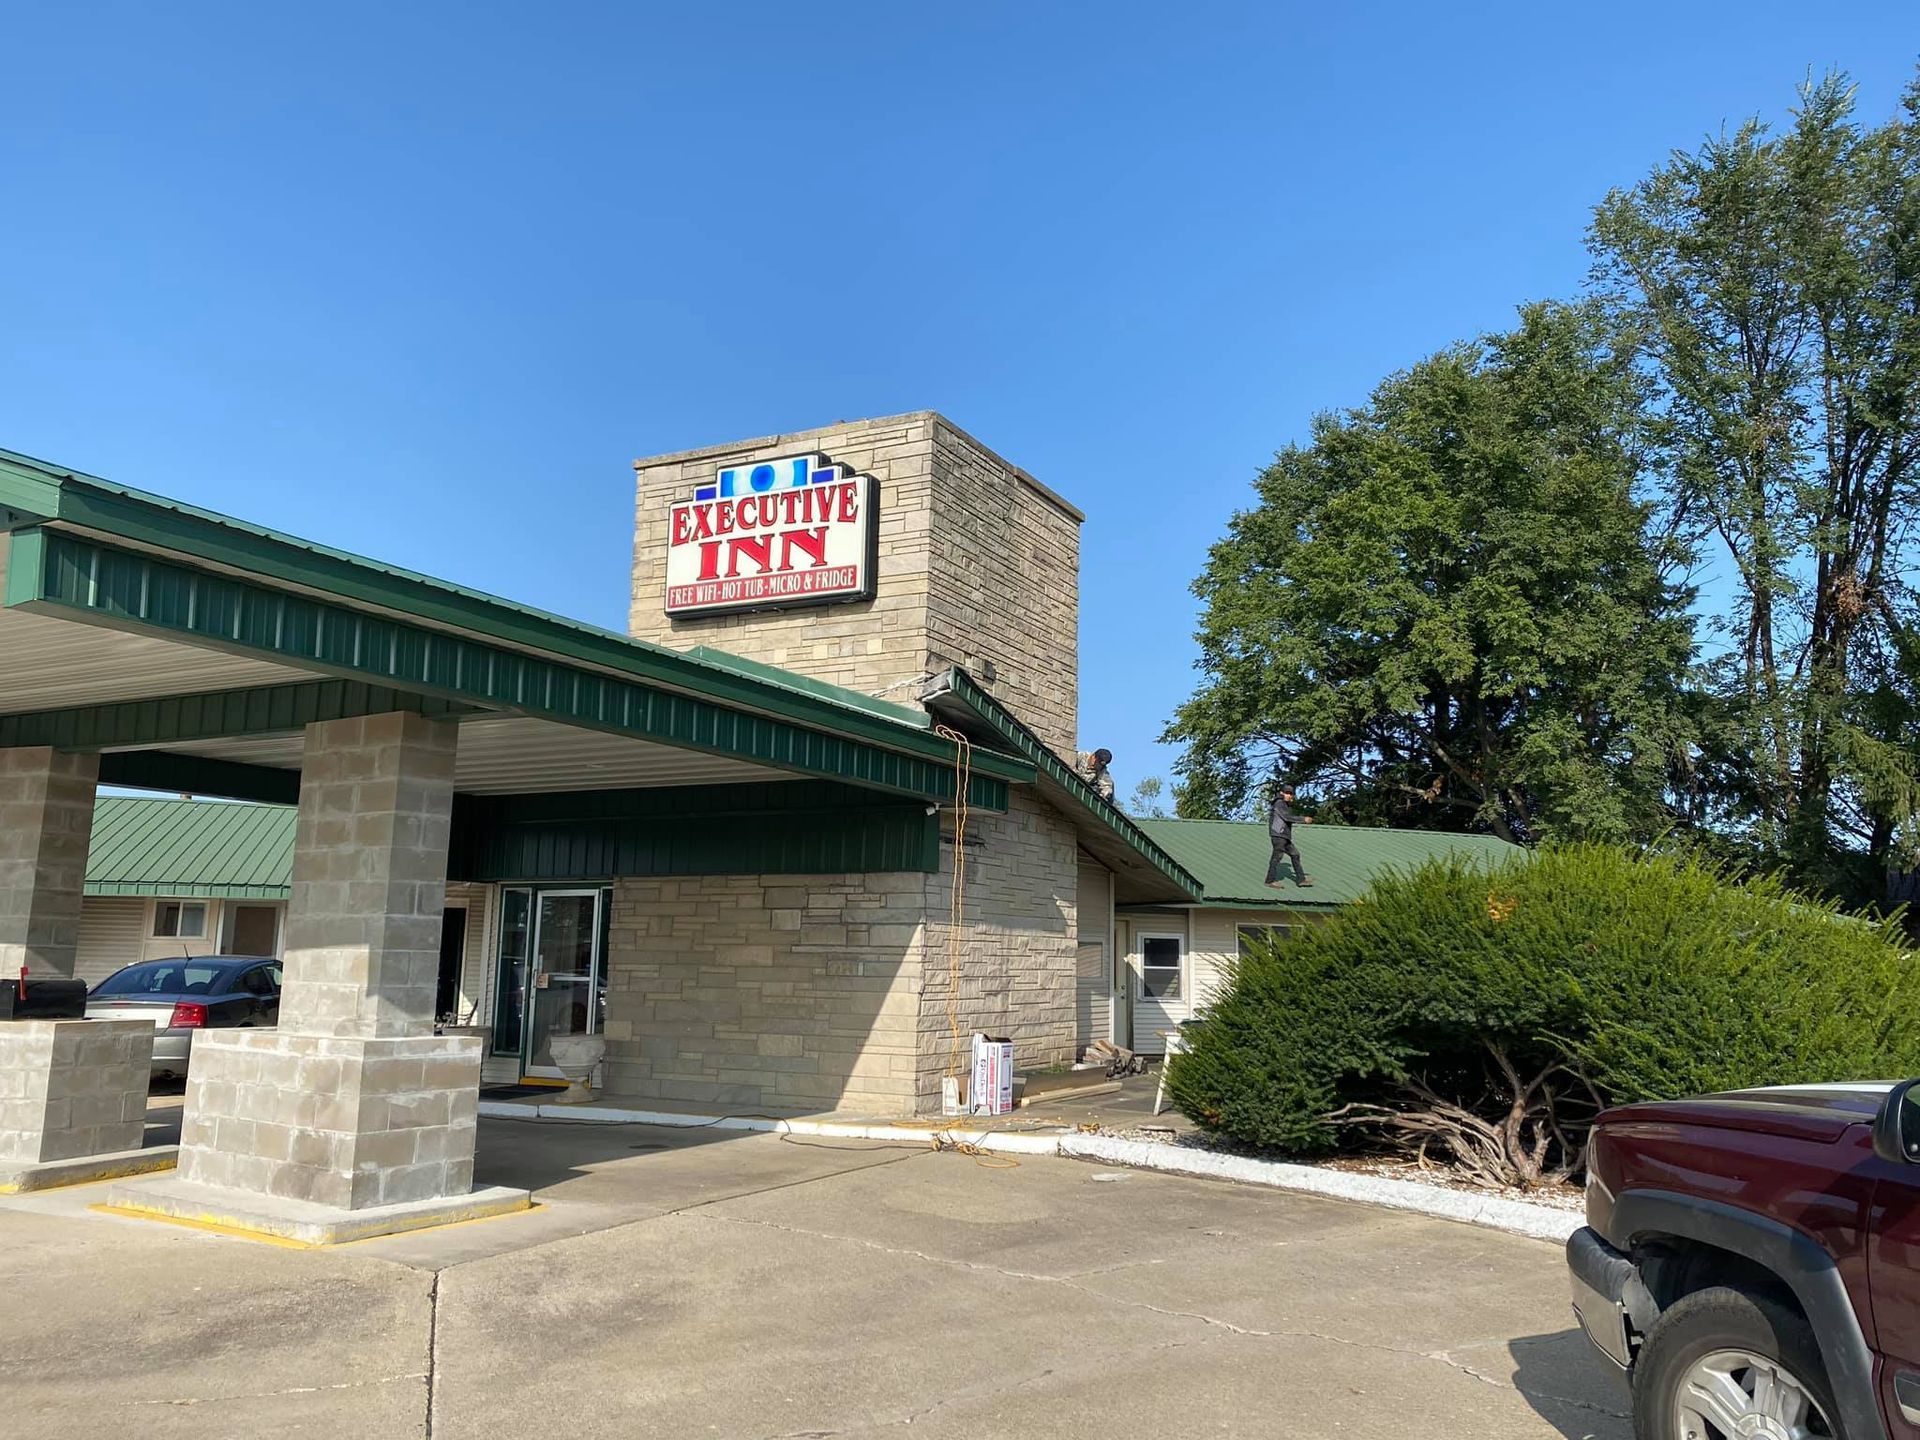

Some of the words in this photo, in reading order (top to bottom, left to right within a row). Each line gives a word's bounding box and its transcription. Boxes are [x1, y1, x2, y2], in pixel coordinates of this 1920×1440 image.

[671, 481, 859, 547] EXECUTIVE
[696, 526, 829, 581] INN
[669, 587, 694, 606] FREE
[803, 572, 813, 591] &
[815, 568, 854, 589] FRIDGE
